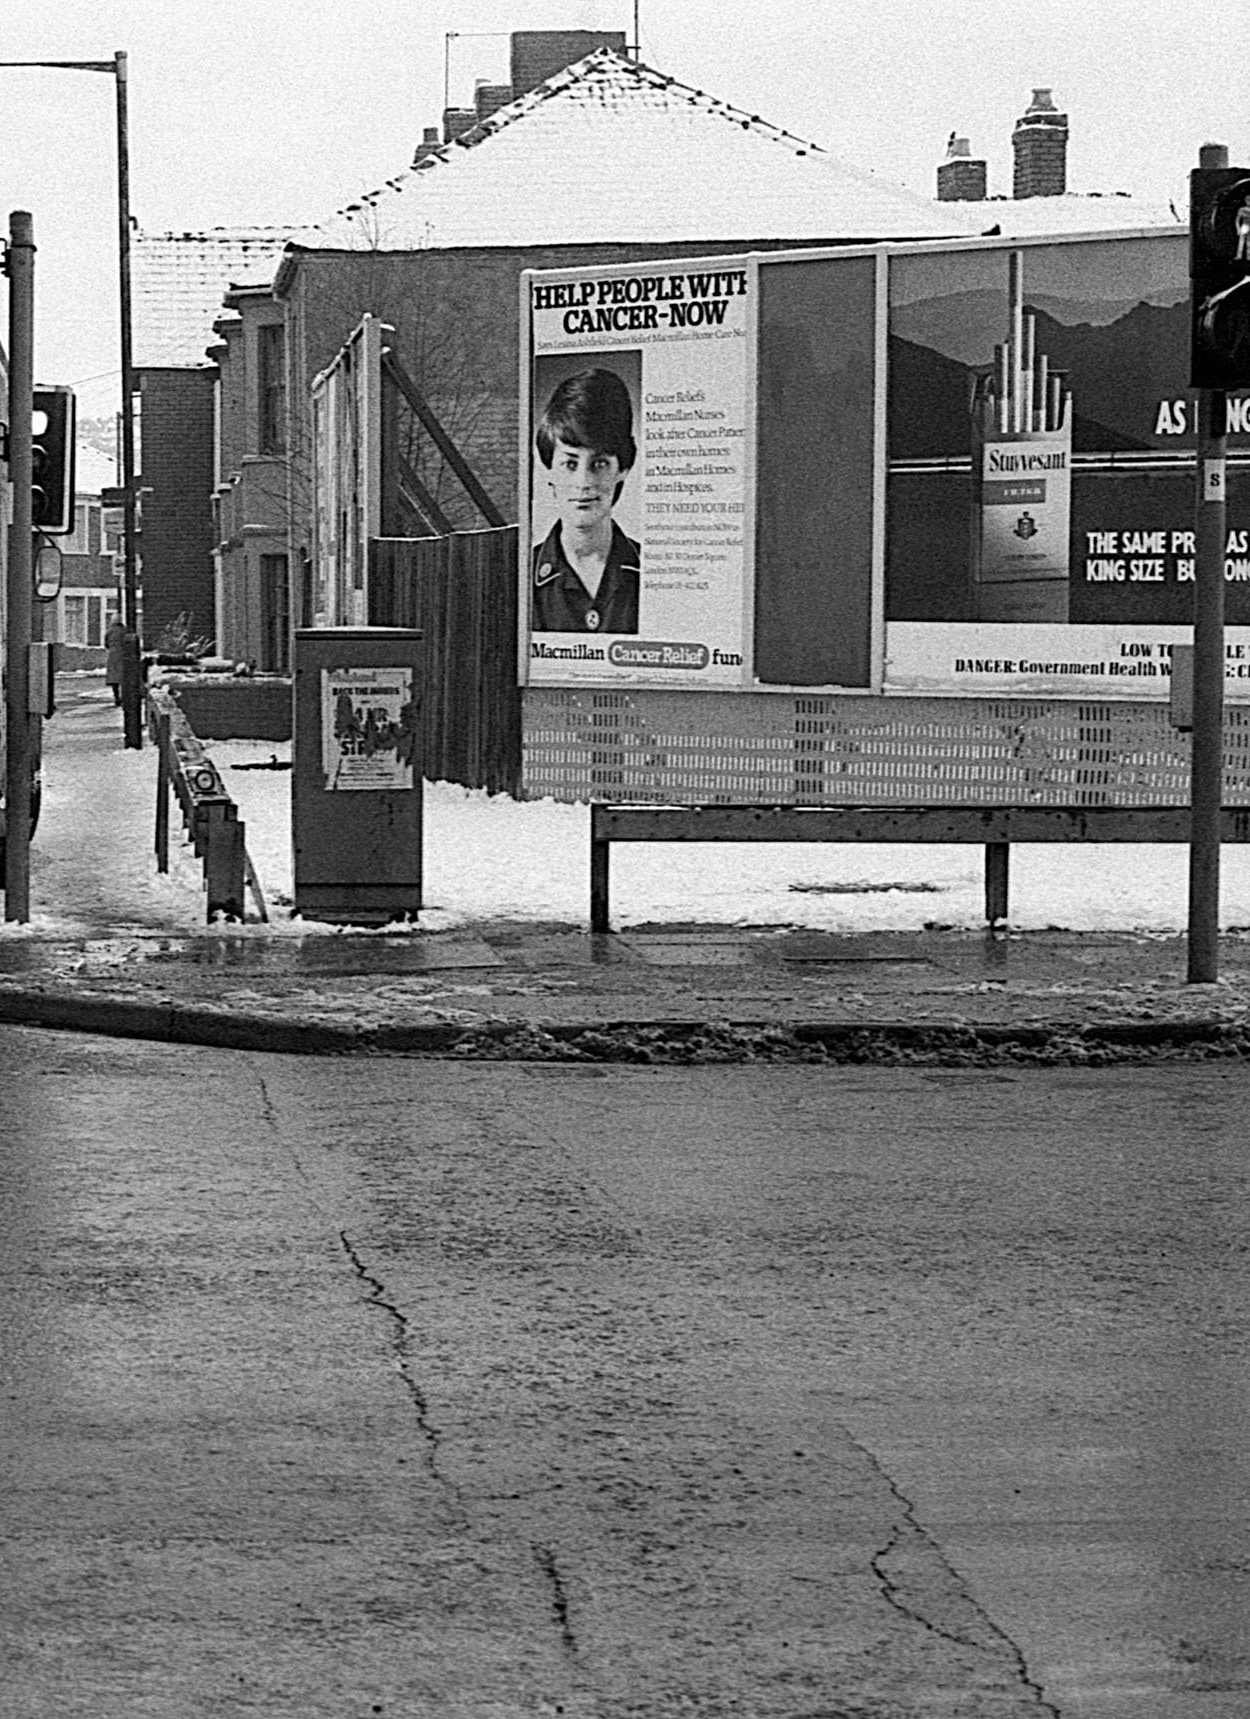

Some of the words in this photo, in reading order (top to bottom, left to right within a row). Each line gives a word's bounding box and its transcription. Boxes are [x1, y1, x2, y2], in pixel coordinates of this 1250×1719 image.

[534, 282, 595, 310] HELP
[597, 275, 684, 305] PEOPLE
[563, 300, 729, 334] CANCER-NOW
[645, 392, 675, 404] Cancer
[1155, 400, 1187, 434] AS
[989, 449, 1066, 475] Stuyvesant
[1210, 473, 1220, 487] S
[645, 503, 671, 513] THEY
[672, 503, 699, 513] NEED
[1086, 532, 1118, 554] THE
[1122, 531, 1167, 554] SAME
[1225, 530, 1249, 553] AS
[1086, 559, 1126, 581] KING
[1129, 559, 1164, 581] SIZE
[531, 643, 605, 661] Macmillan
[611, 644, 662, 663] Cancer
[662, 647, 704, 665] Relief
[1120, 643, 1152, 657] LOW
[955, 658, 1017, 673] DANGER:
[1019, 659, 1107, 675] Government
[1109, 661, 1156, 676] Health
